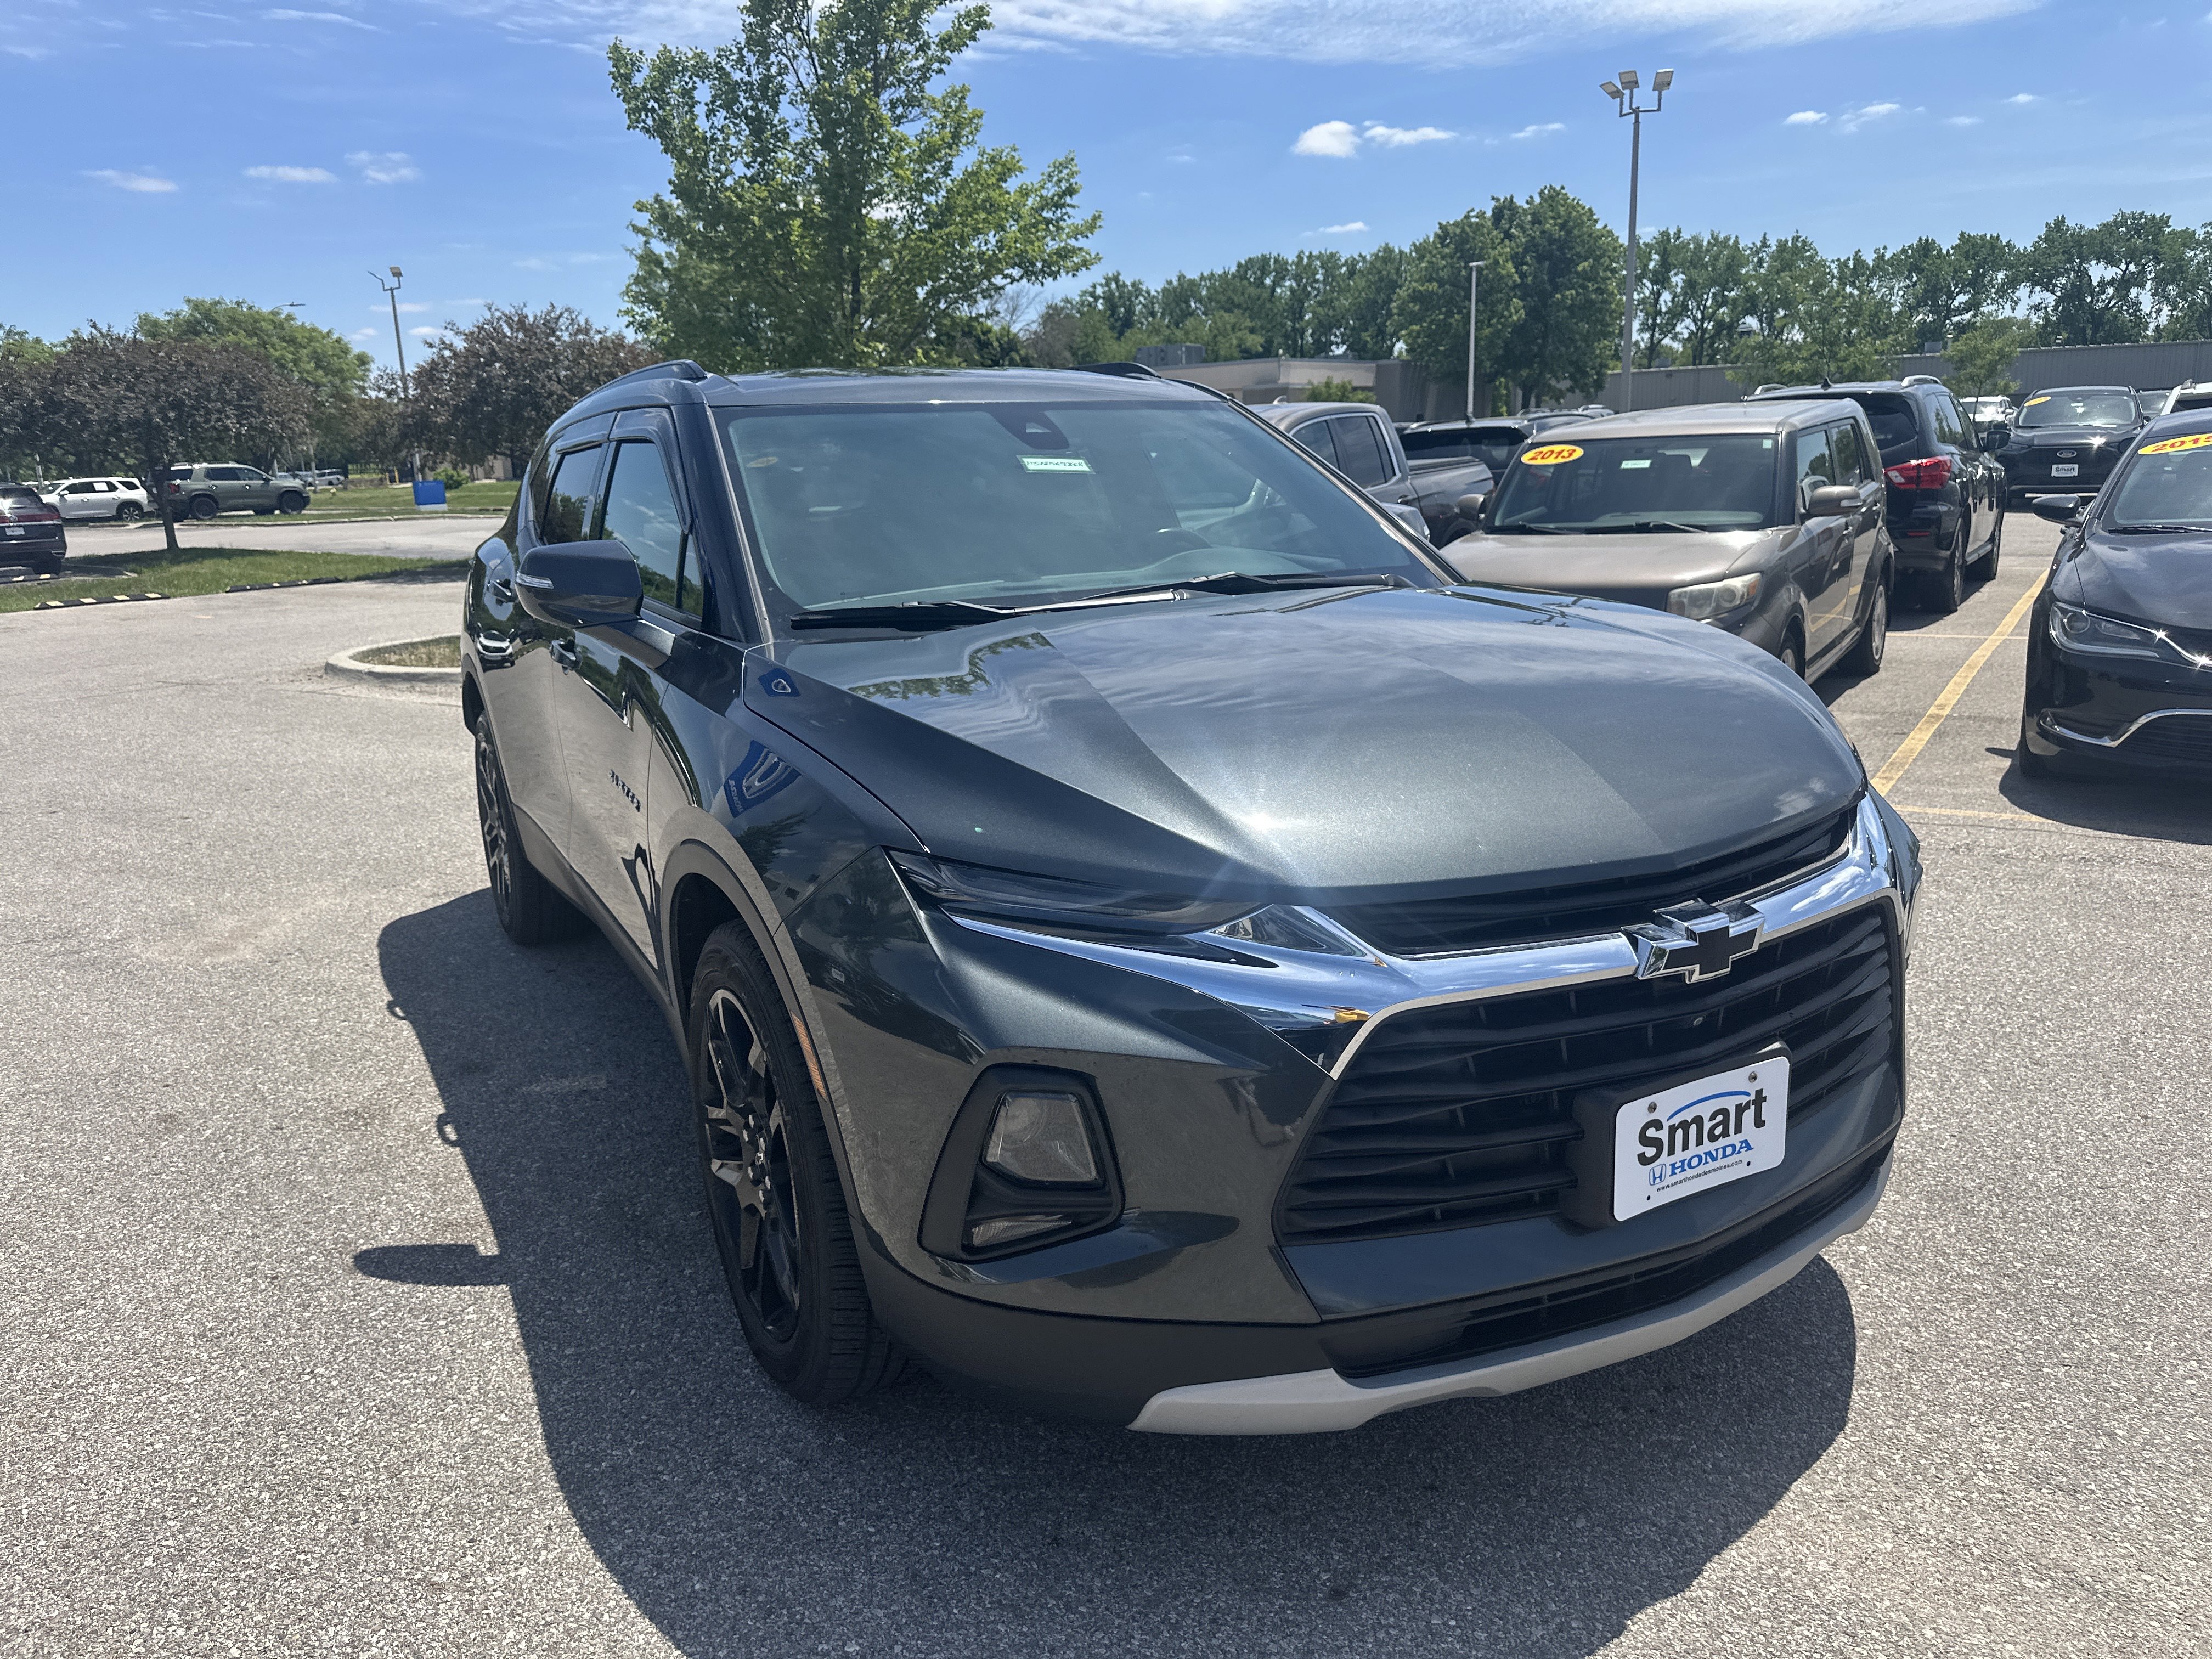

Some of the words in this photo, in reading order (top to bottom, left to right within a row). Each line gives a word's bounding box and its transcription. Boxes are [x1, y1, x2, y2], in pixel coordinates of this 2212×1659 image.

[1527, 448, 1577, 461] 2013
[1637, 1088, 1767, 1166] Smart
[1656, 1159, 1743, 1193] www.smarthondadesmoines.com
[1668, 1139, 1754, 1177] HONDA
